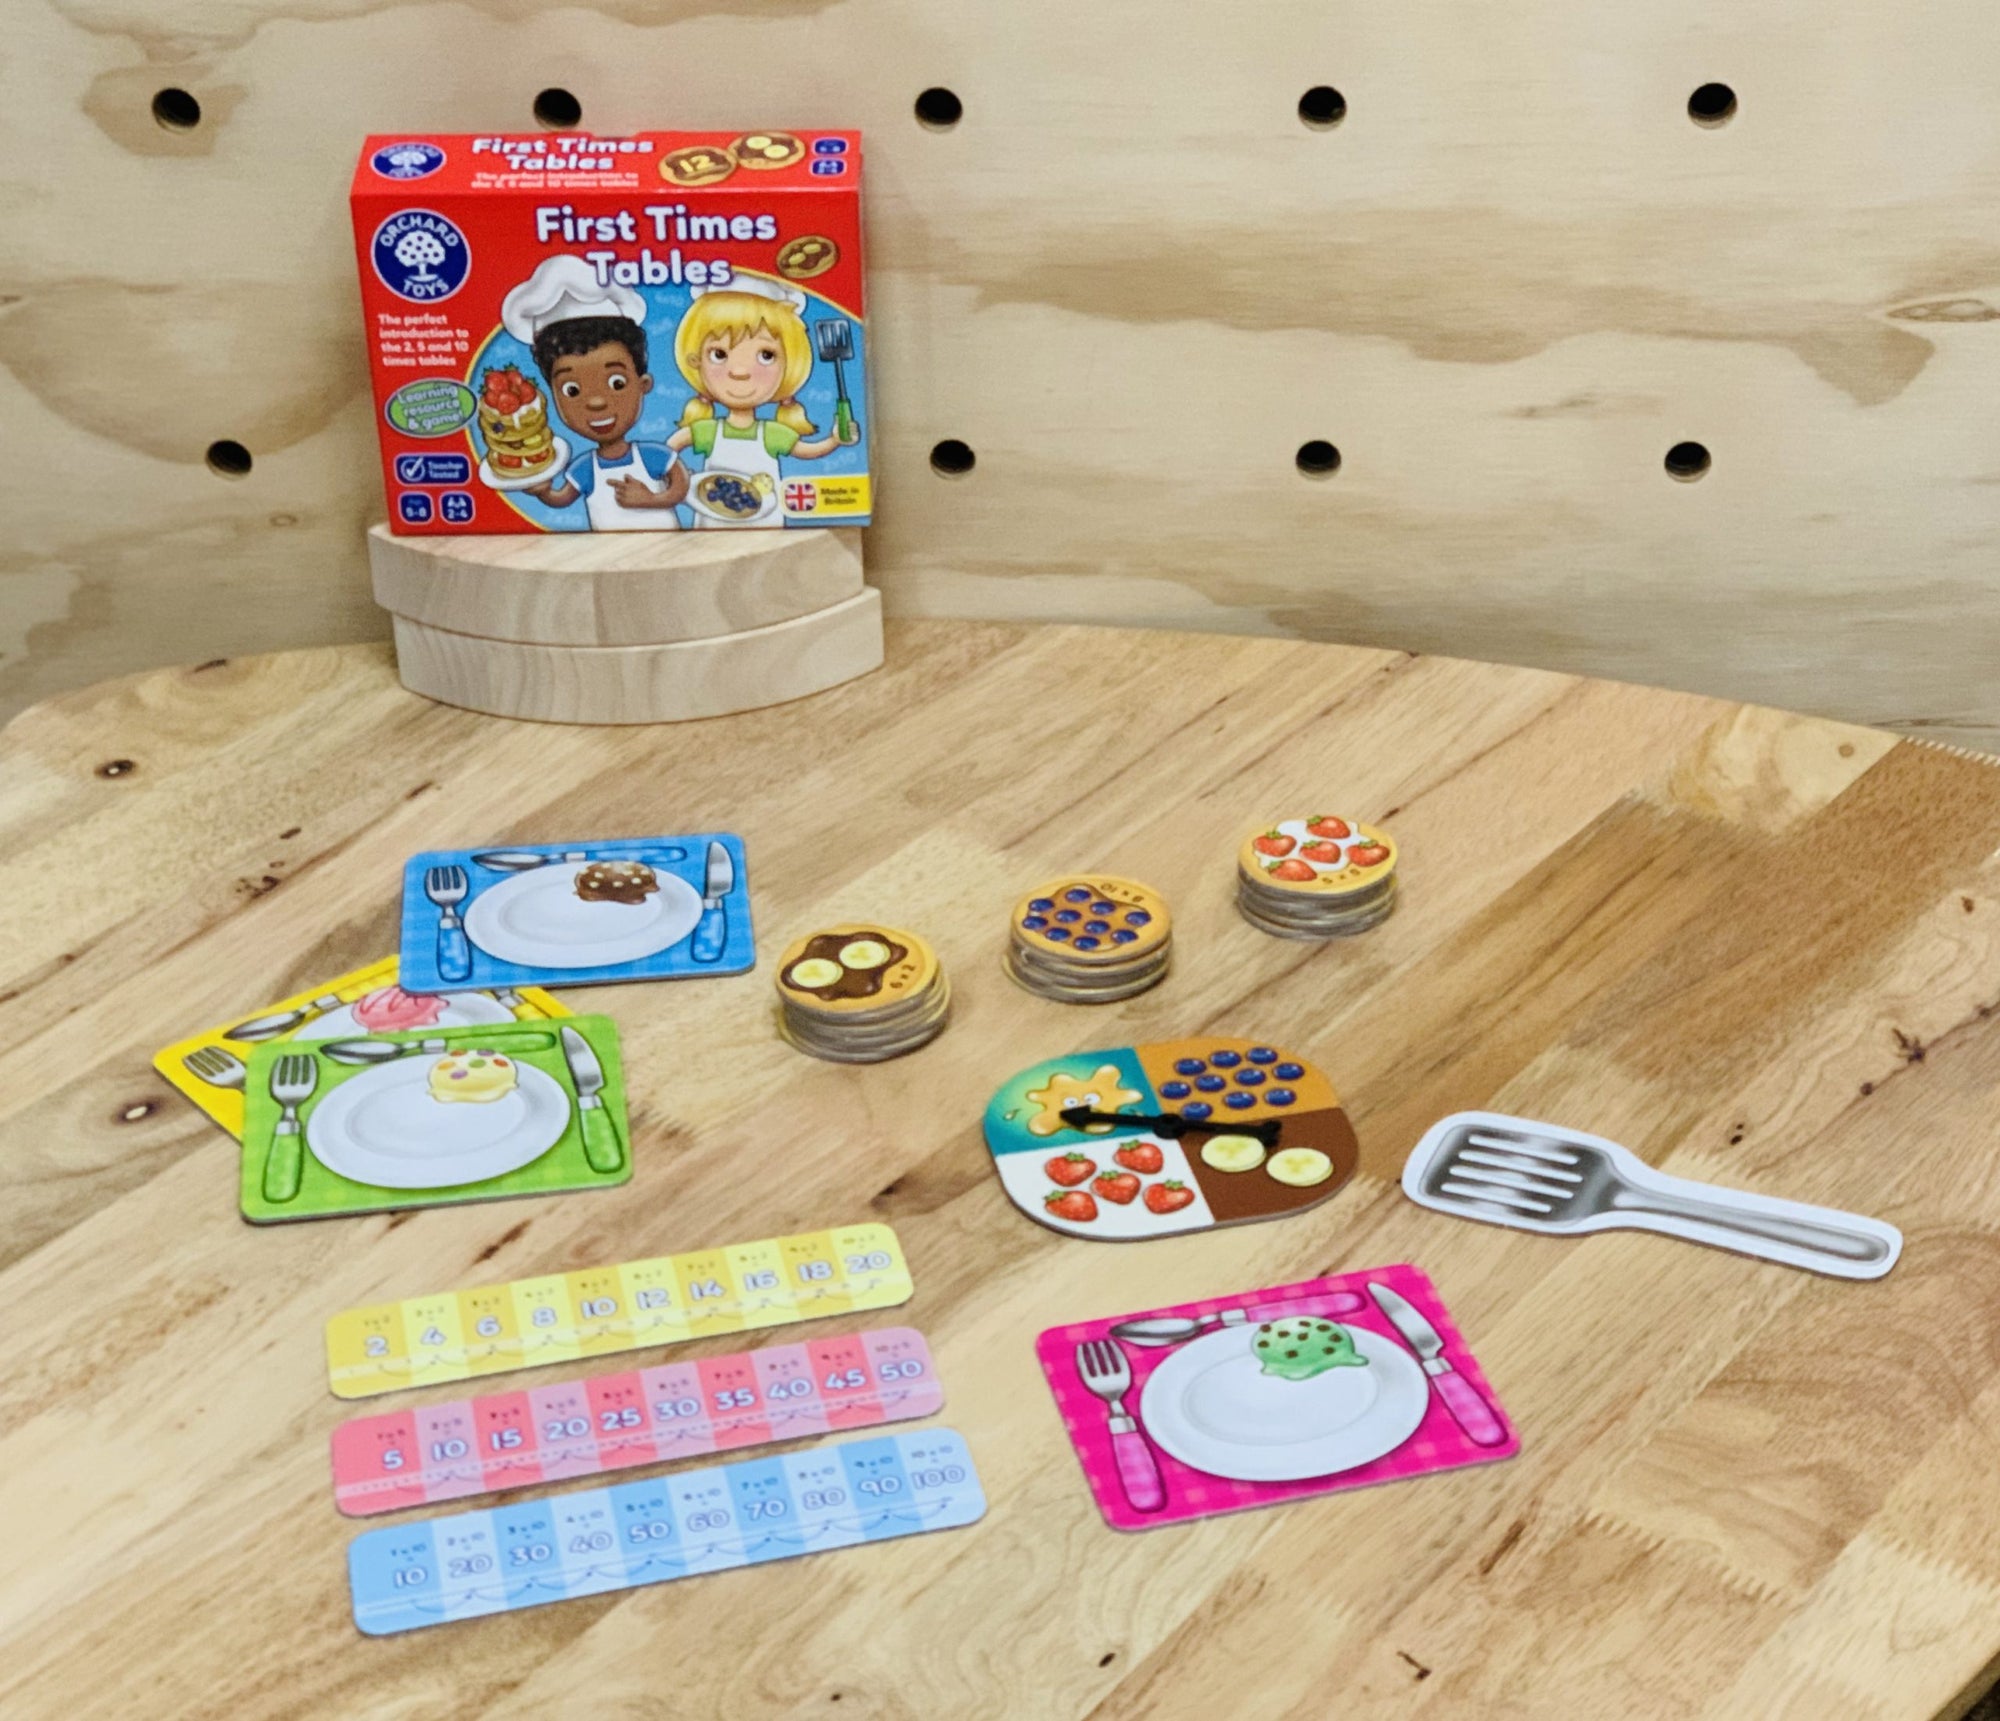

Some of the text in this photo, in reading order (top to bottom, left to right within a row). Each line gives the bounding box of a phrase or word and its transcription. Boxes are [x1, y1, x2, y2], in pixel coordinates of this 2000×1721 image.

[472, 136, 654, 154] First Times
[506, 153, 614, 170] Tables
[680, 155, 714, 174] 12
[380, 215, 460, 247] ORCHARD
[536, 204, 777, 242] First Times
[586, 248, 732, 286] Tables
[403, 279, 450, 298] TOYS
[377, 312, 448, 327] The perfect
[379, 327, 469, 339] introduction to
[381, 341, 401, 353] the
[428, 340, 452, 353] and
[454, 341, 470, 353] 10
[382, 354, 456, 366] times tables
[397, 385, 458, 404] Learning
[404, 399, 460, 417] resource
[408, 410, 463, 431] & game!
[821, 487, 848, 495] Made
[824, 498, 857, 506] Britain
[447, 508, 468, 520] 2-4
[365, 1335, 390, 1357] 2
[420, 1326, 446, 1346] 4
[475, 1316, 502, 1337] 6
[532, 1306, 557, 1328] 8
[581, 1296, 618, 1319] 10
[636, 1288, 671, 1310] 12
[689, 1279, 727, 1301] 14
[744, 1269, 779, 1292] 16
[797, 1259, 834, 1282] 18
[844, 1250, 892, 1274] 20
[382, 1449, 405, 1470] 5
[431, 1438, 469, 1462] 10
[490, 1428, 523, 1451] 15
[545, 1417, 590, 1442] 20
[600, 1406, 643, 1431] 25
[656, 1397, 700, 1421] 30
[714, 1387, 756, 1411] 35
[767, 1378, 813, 1401] 40
[824, 1368, 867, 1390] 45
[879, 1359, 924, 1382] 50
[394, 1465, 966, 1589] 10 20 30 40 50 60 70 80 90 100
